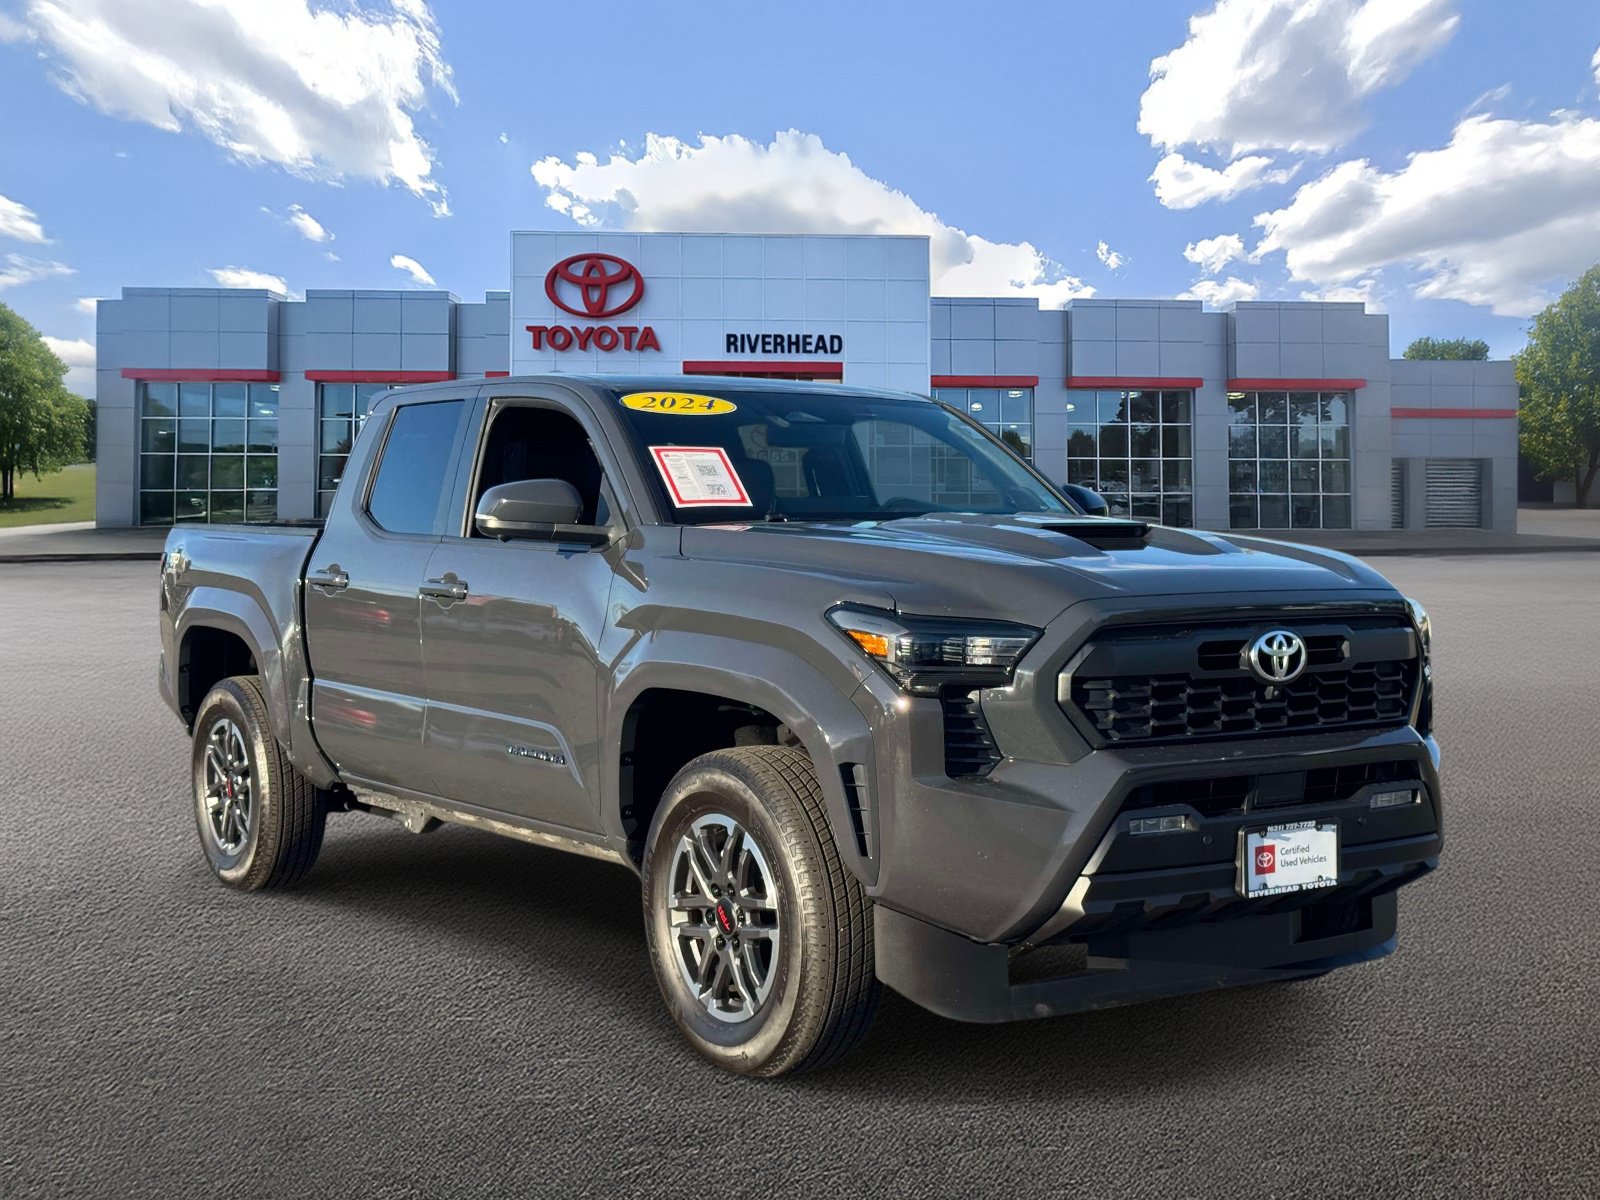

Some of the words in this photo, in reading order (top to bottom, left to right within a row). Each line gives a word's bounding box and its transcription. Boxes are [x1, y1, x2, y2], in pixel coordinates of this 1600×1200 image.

[526, 325, 661, 352] TOYOTA
[725, 333, 843, 355] RIVERHEAD
[641, 396, 715, 411] 2024
[1280, 844, 1310, 856] Certified
[1280, 857, 1298, 868] Used
[1299, 854, 1327, 866] Vehicles
[1248, 885, 1300, 899] RIVERHEAD
[1302, 879, 1338, 891] TOYOTA
